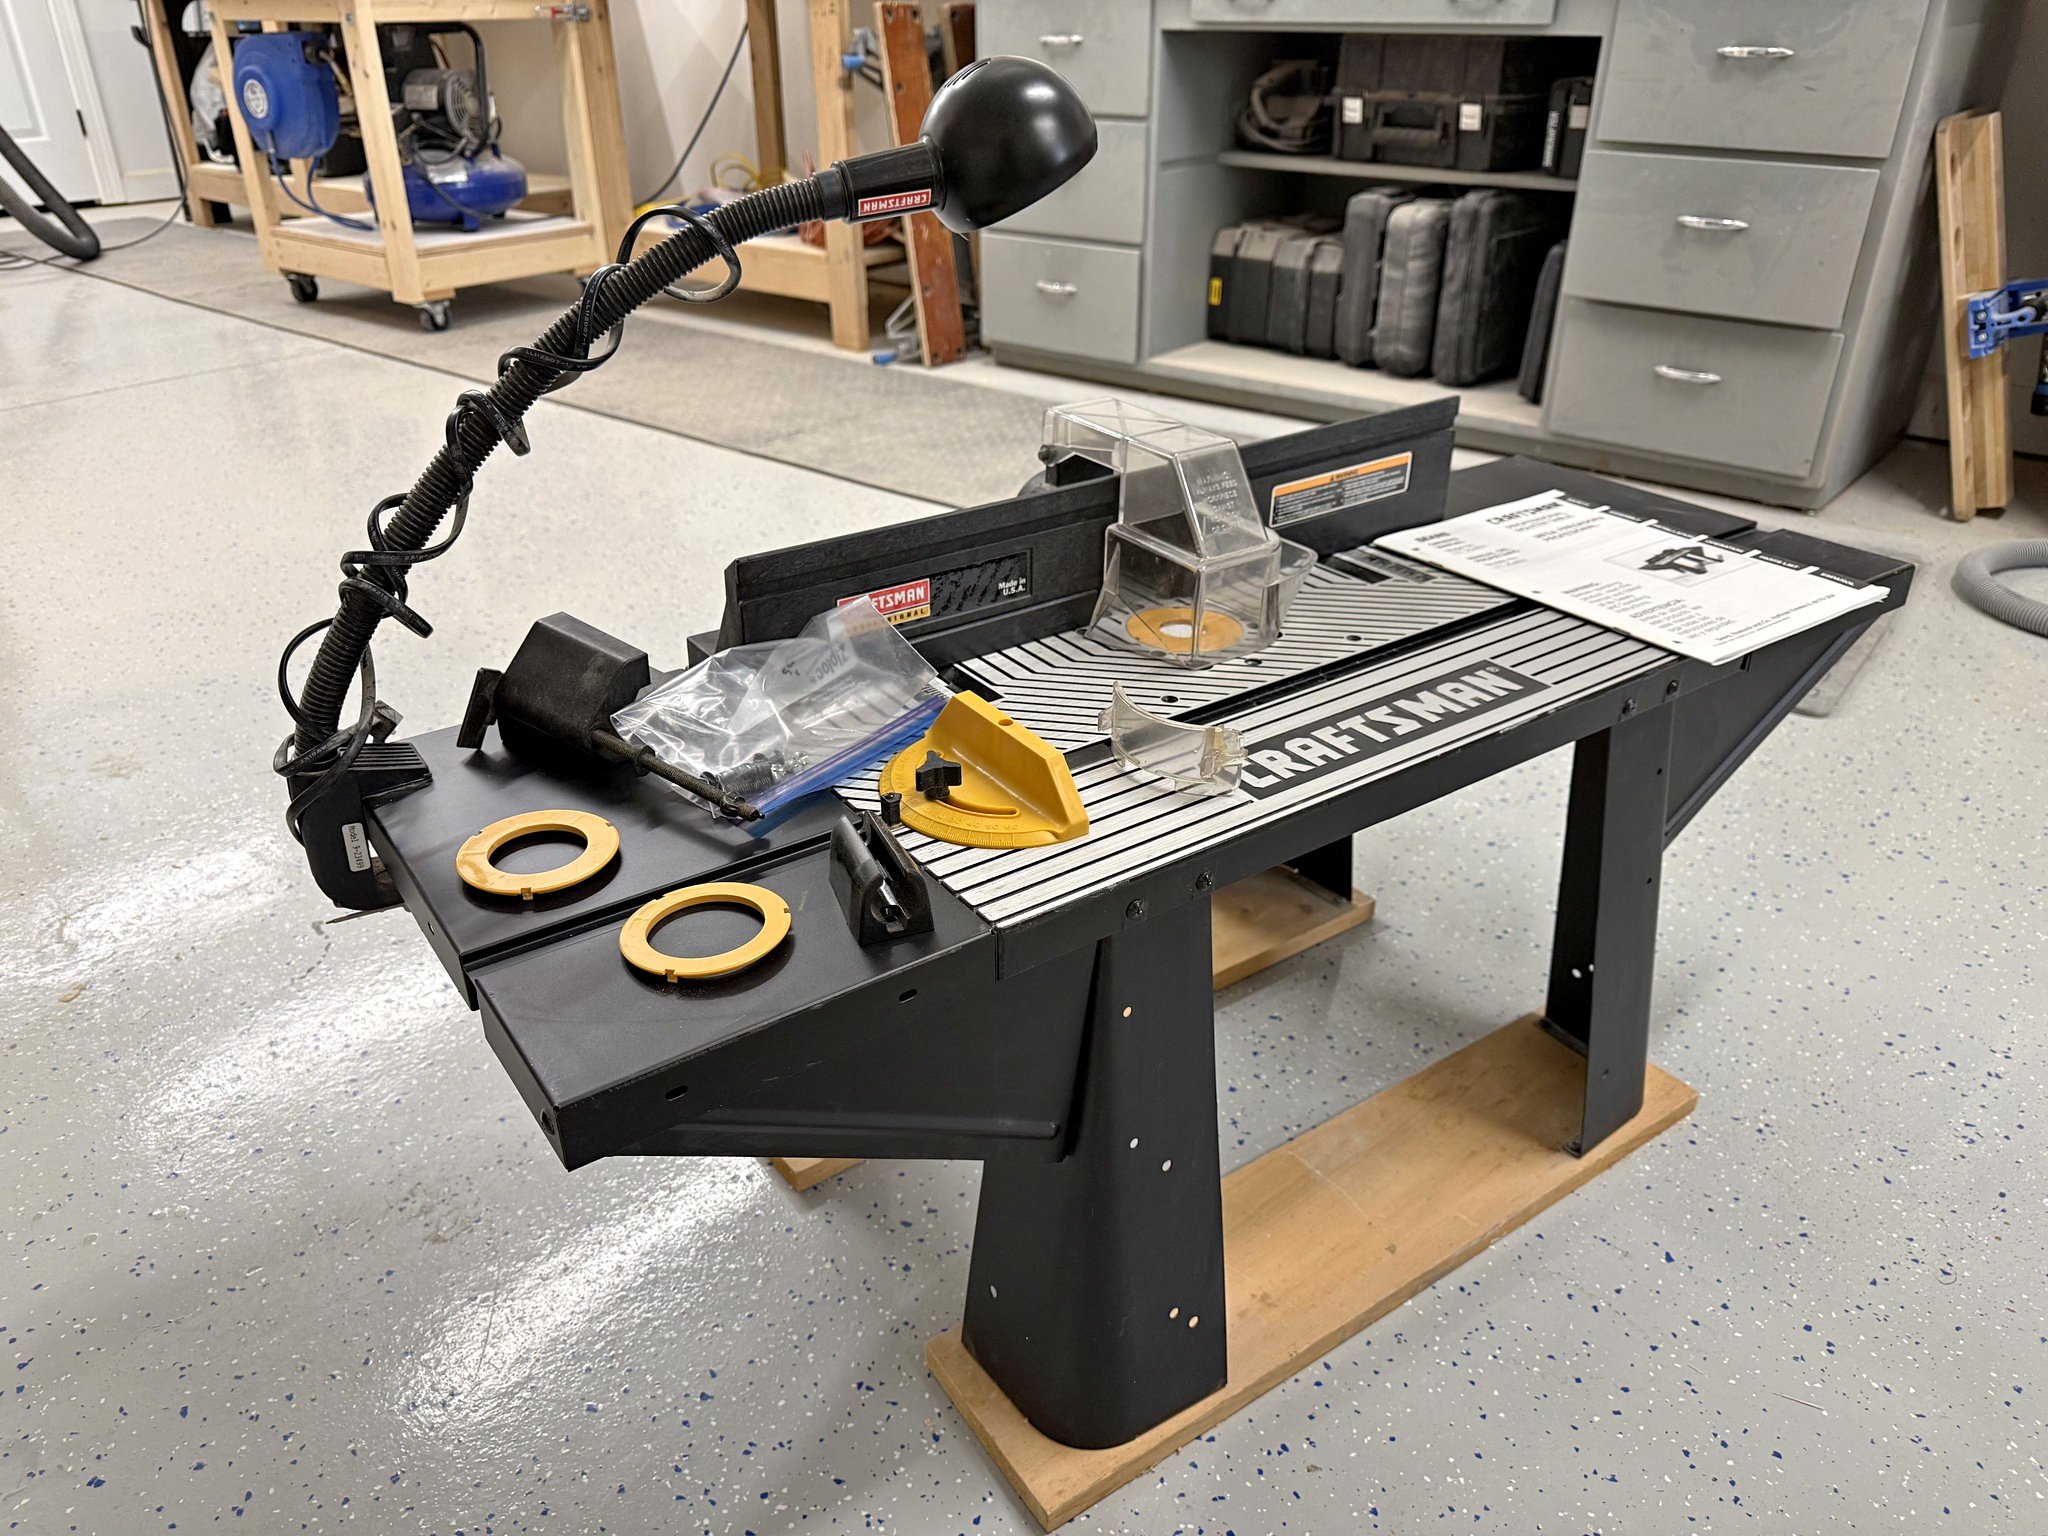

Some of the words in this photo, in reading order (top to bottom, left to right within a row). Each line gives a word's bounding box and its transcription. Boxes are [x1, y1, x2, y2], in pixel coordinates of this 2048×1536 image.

[863, 194, 927, 212] CRAFTSMAN
[998, 580, 1017, 590] Made
[1003, 585, 1026, 596] U.S.A.
[1241, 669, 1524, 788] CRAFTSMAN
